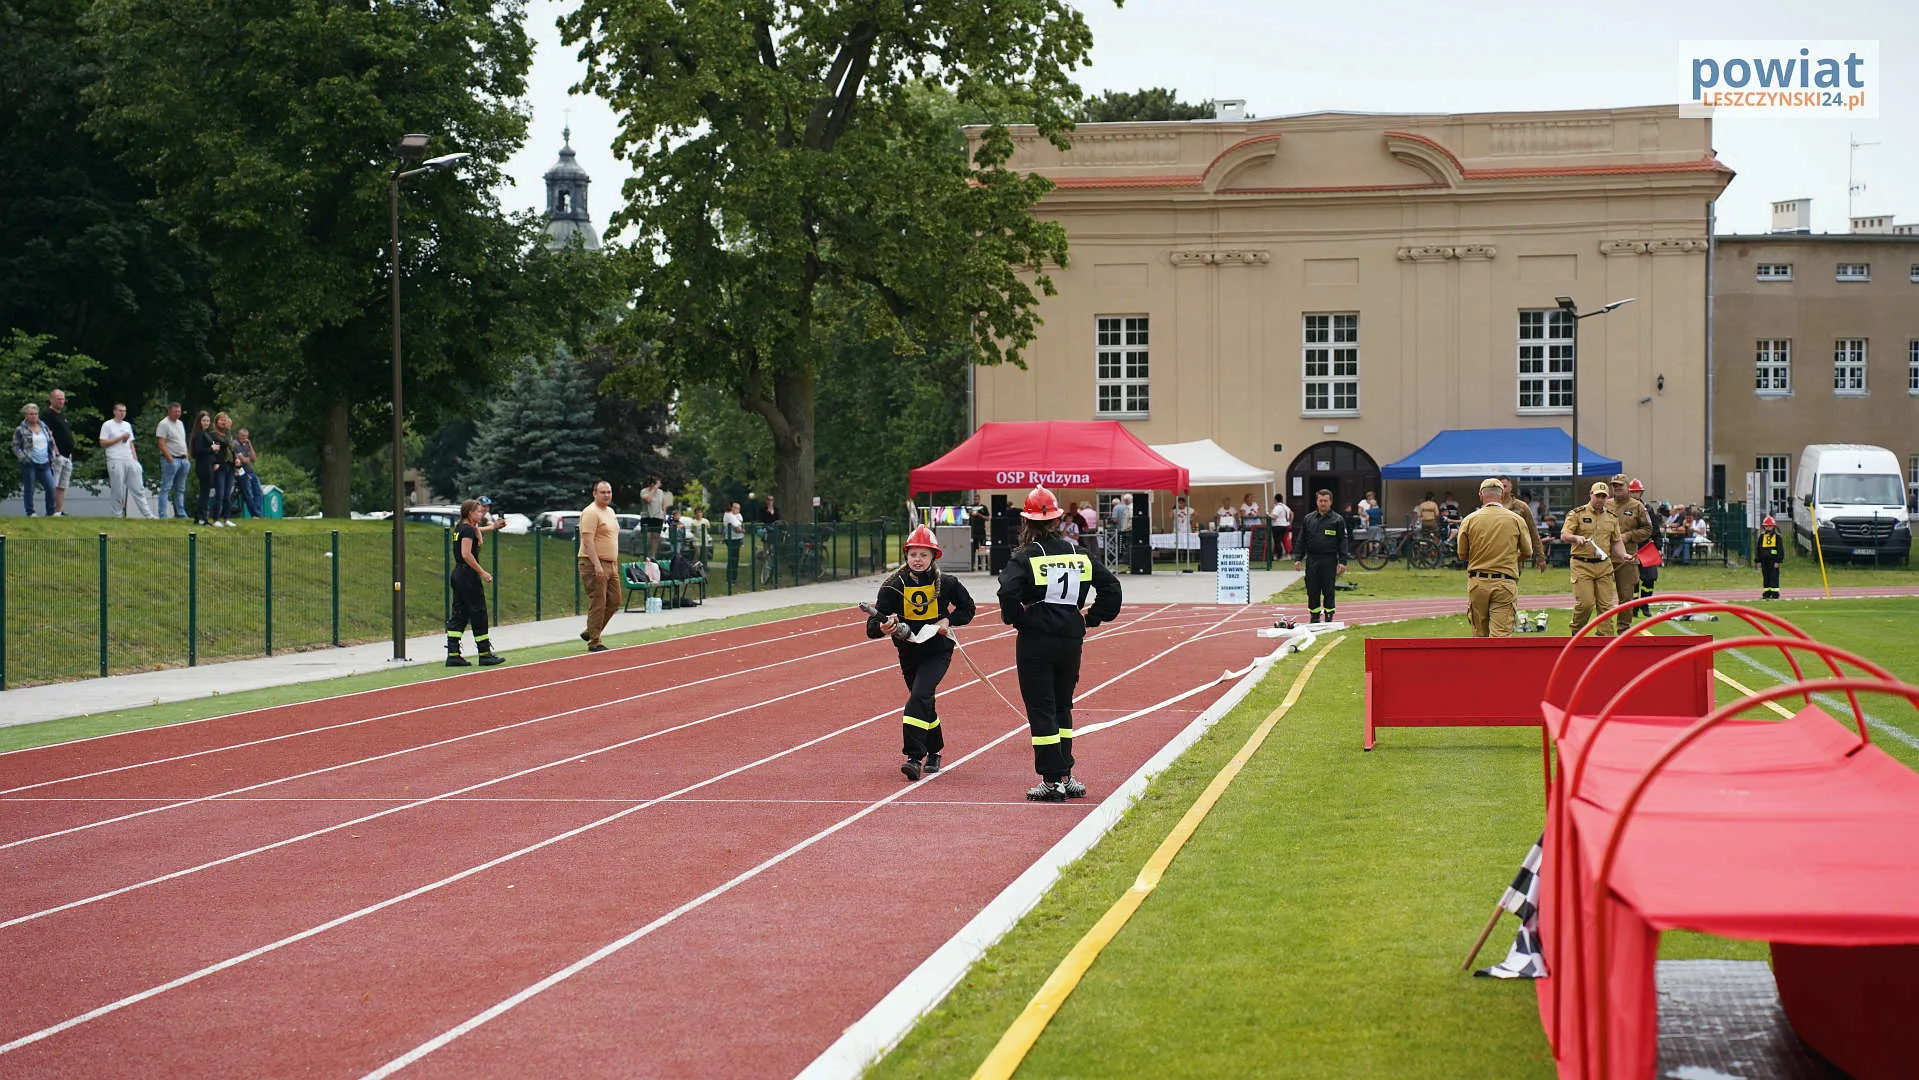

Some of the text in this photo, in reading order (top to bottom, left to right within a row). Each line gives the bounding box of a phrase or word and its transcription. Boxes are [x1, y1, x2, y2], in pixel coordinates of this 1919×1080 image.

[996, 470, 1090, 486] OSP Rydzyna
[1057, 571, 1069, 600] 1
[911, 590, 929, 616] 9
